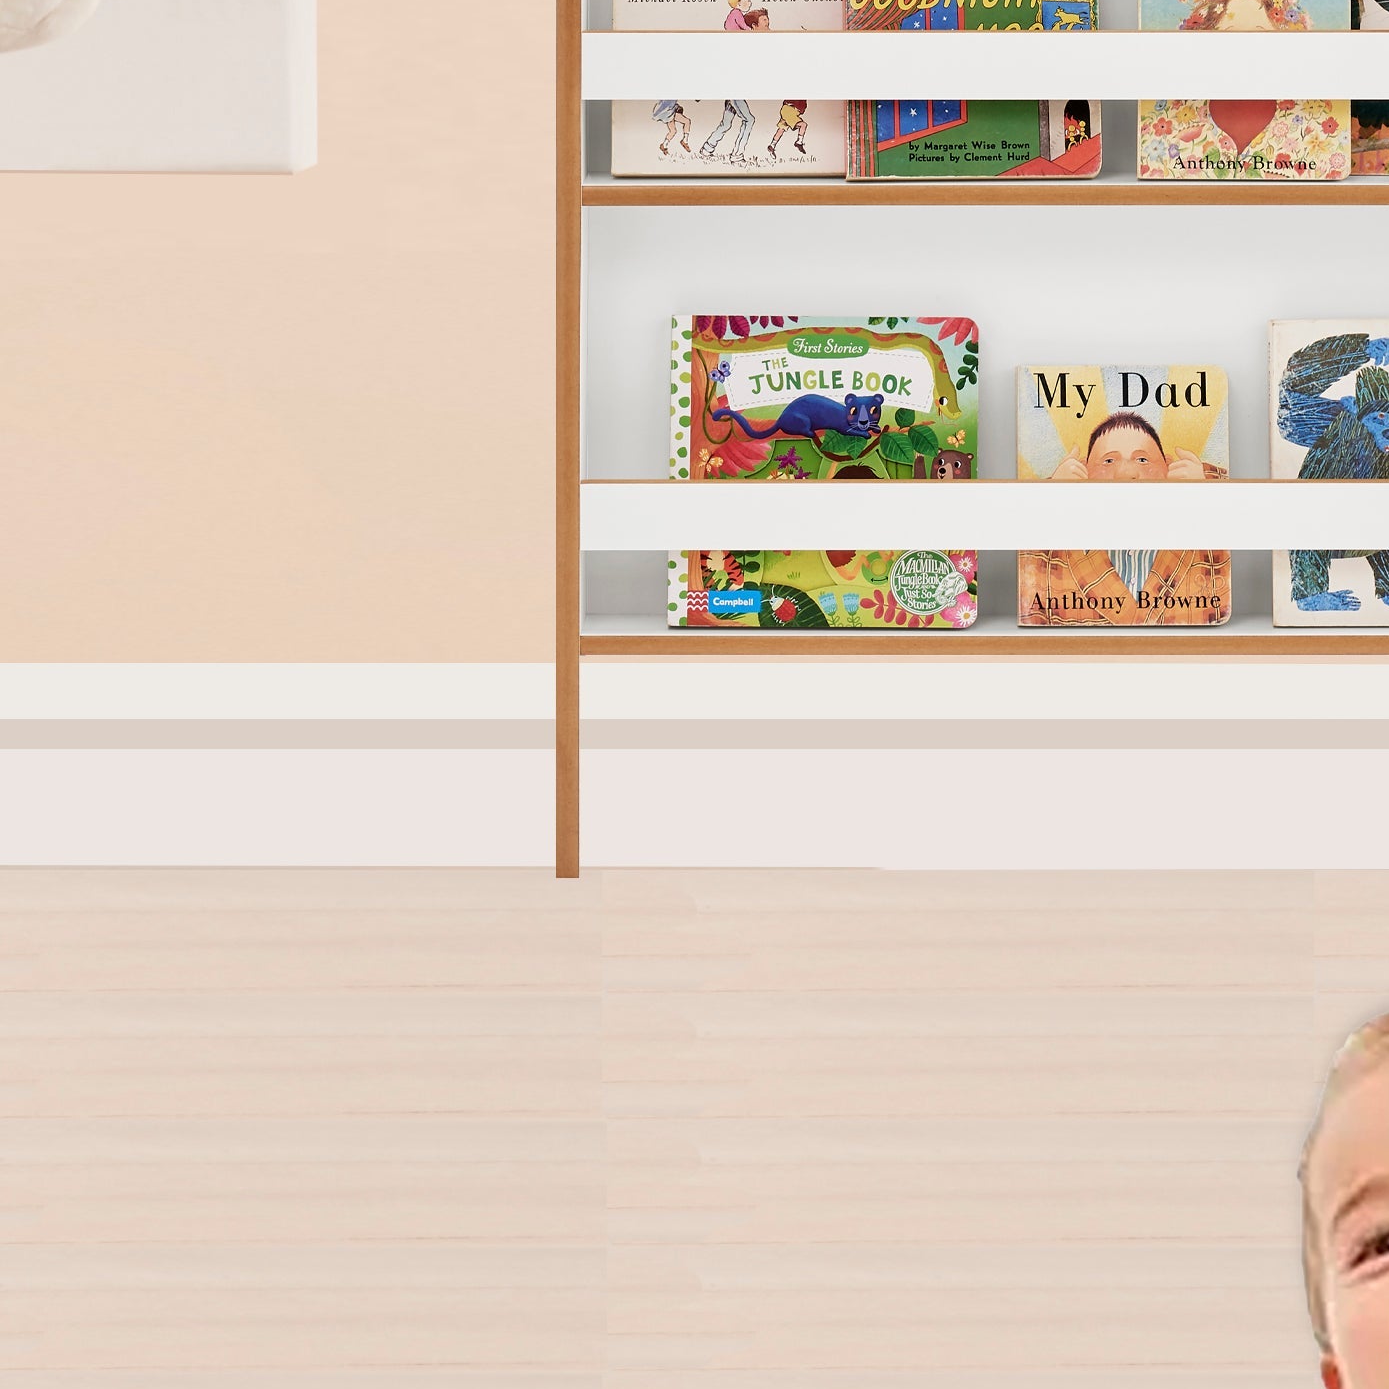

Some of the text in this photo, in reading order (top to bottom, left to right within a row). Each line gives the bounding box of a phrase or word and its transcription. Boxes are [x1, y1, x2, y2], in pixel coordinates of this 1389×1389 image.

[909, 140, 1030, 152] by Margaret Wise Brown
[909, 152, 1030, 163] Pictures by Clement Hurd
[1173, 155, 1316, 172] Anthony Browne
[792, 338, 864, 354] First Stories
[762, 357, 788, 371] THE
[748, 369, 912, 396] JUNGLE BOOK
[1033, 371, 1211, 418] My Dad
[713, 597, 754, 607] Campbell
[908, 597, 936, 609] Stories
[1030, 591, 1221, 614] Anthony Browne
